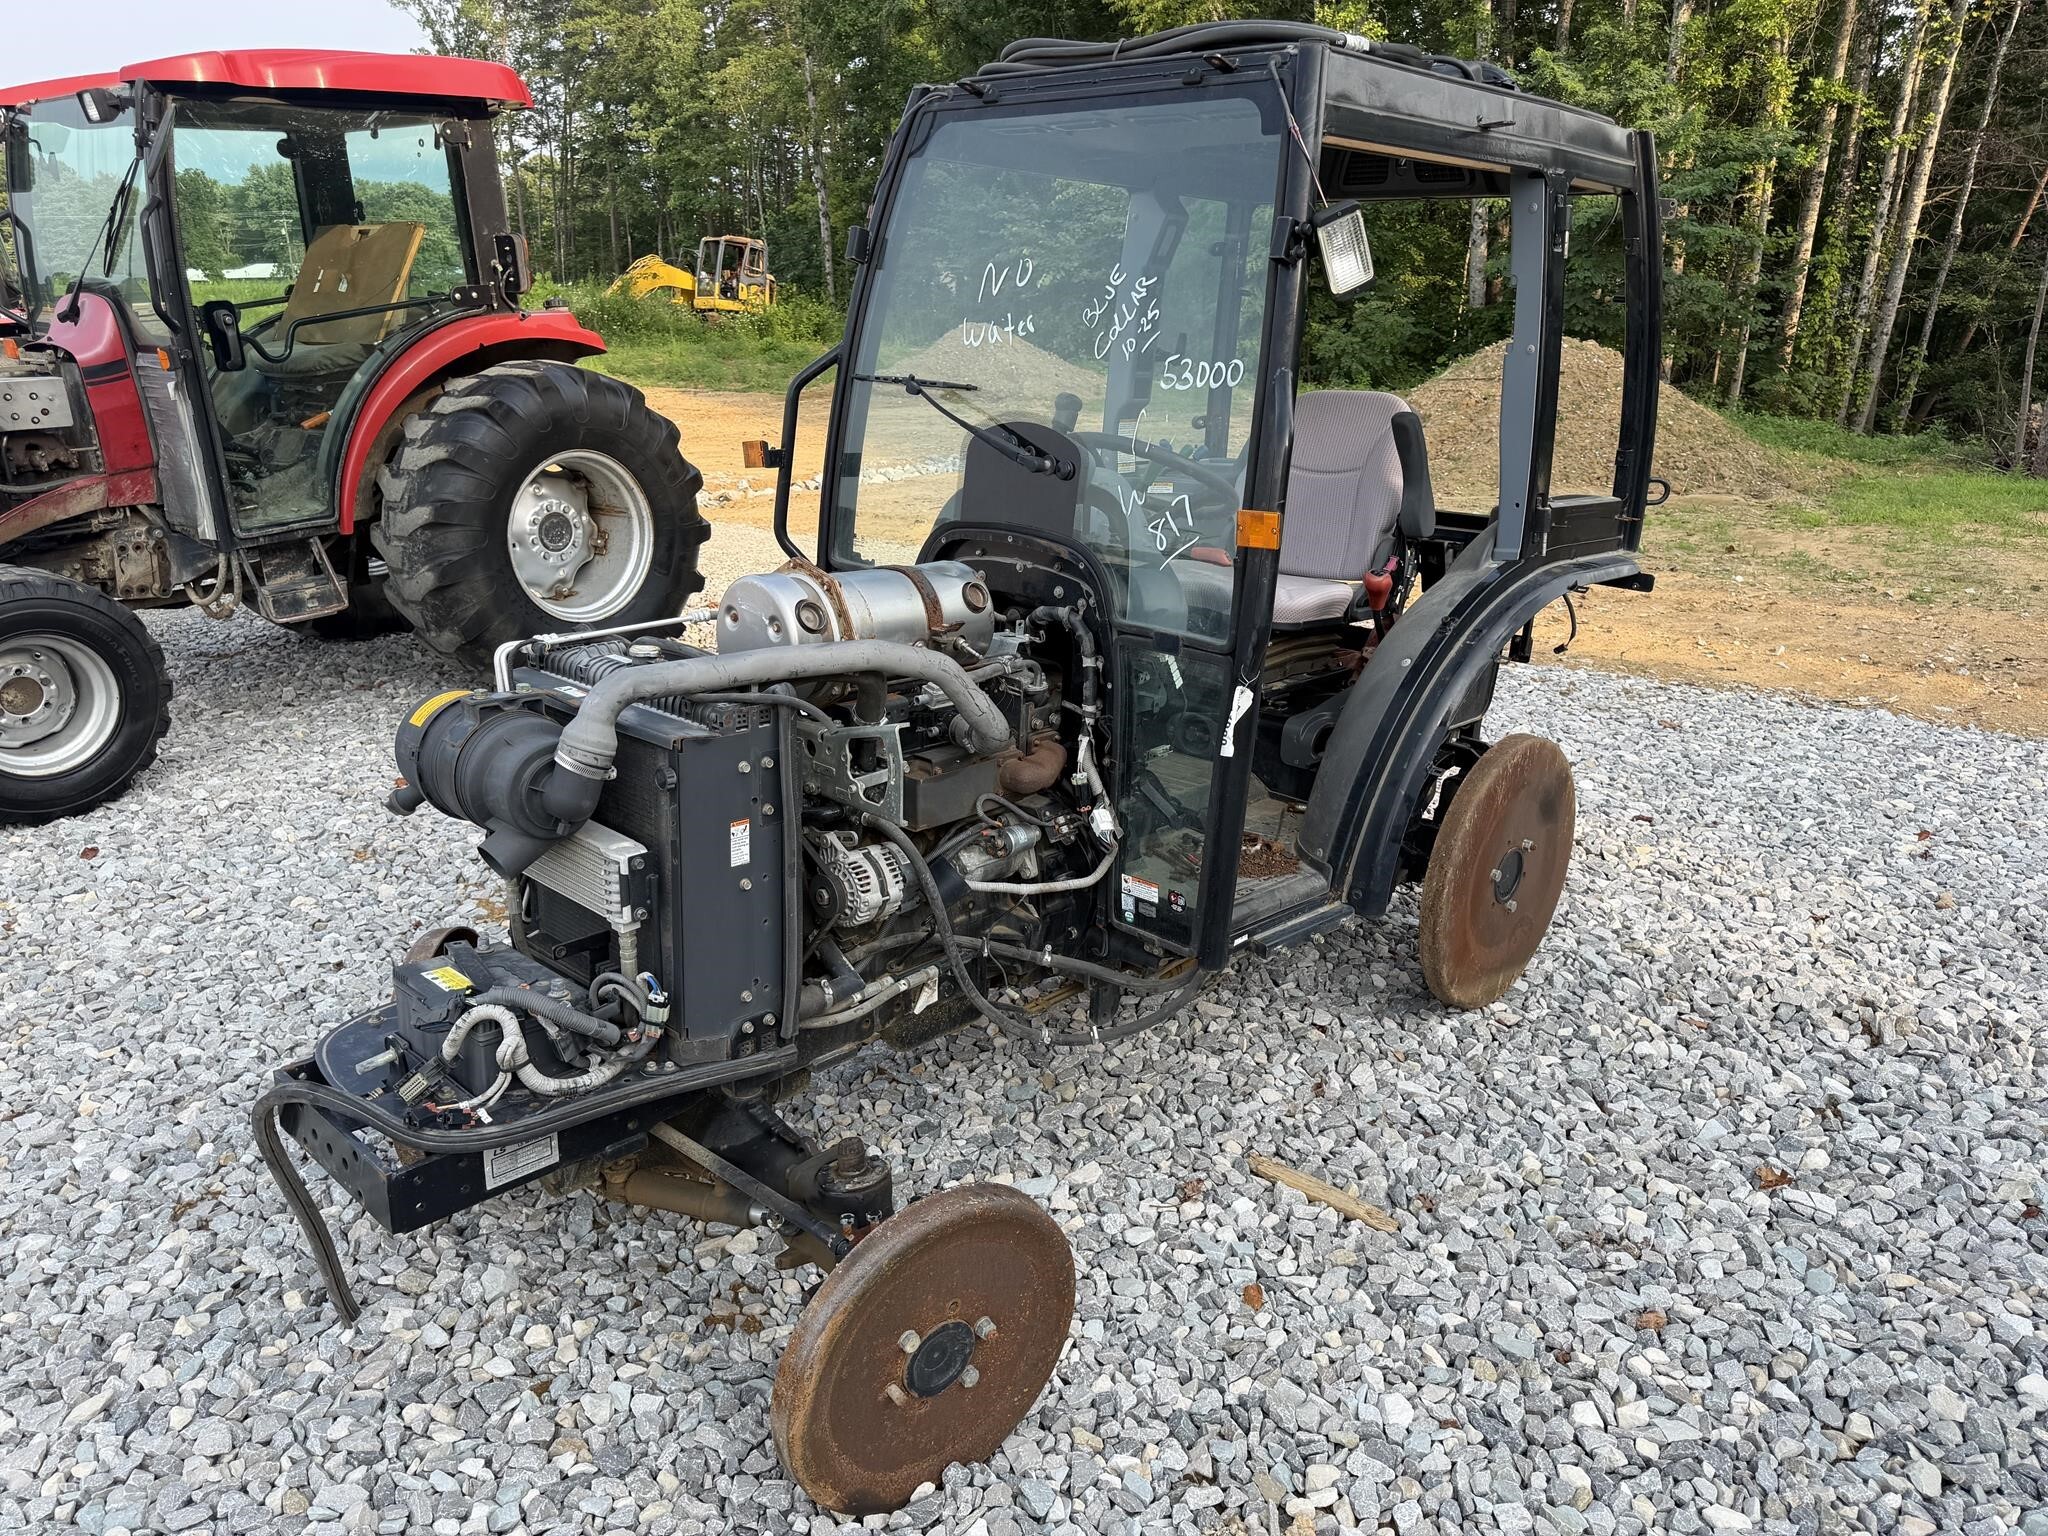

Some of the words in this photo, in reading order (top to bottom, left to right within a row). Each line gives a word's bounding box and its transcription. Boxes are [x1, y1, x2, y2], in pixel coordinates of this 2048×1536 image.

[978, 258, 1033, 303] NO
[1082, 263, 1127, 329] BLUE
[1160, 353, 1244, 391] 53000
[1147, 494, 1194, 551] 817
